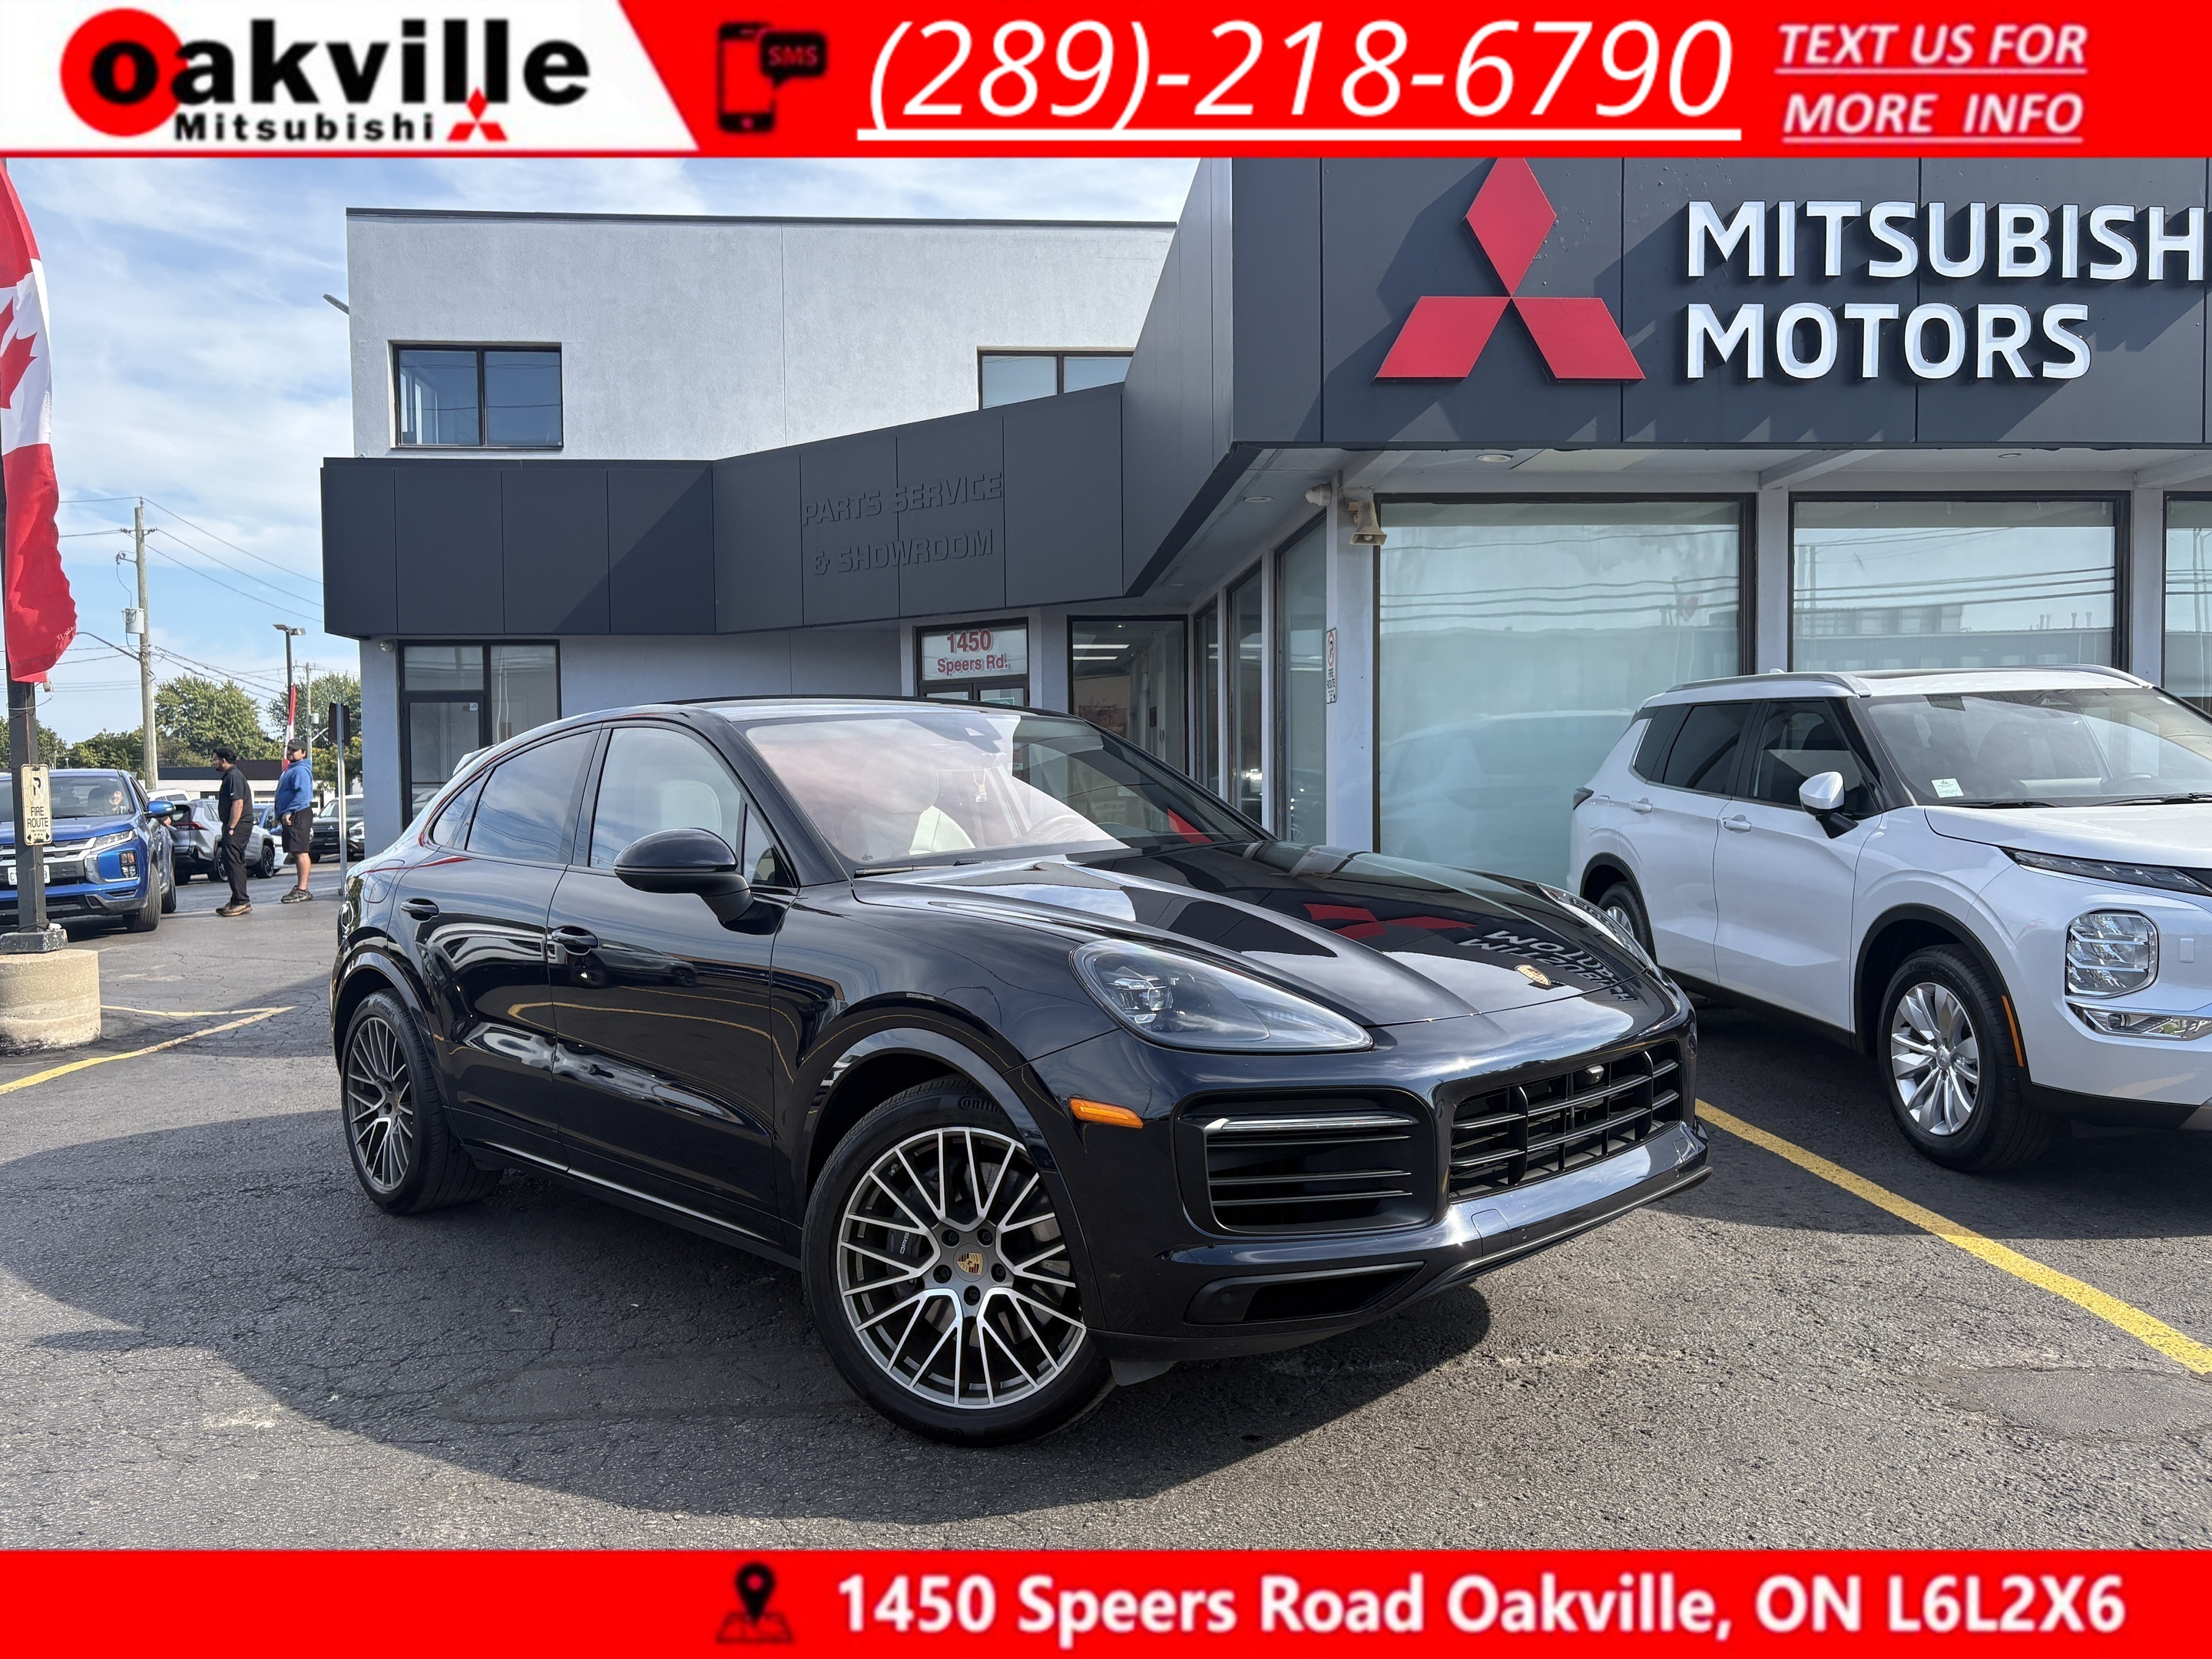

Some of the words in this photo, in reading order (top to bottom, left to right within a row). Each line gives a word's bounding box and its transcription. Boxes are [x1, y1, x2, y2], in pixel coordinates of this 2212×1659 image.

[1687, 200, 2206, 281] MITSUBISH
[1687, 303, 2092, 380] MOTORS
[803, 490, 882, 528] PARTS
[892, 472, 1002, 514] SERVICE
[813, 550, 830, 576] &
[837, 528, 994, 574] SHOWROOM
[945, 629, 992, 654] 1450
[937, 656, 982, 677] Speers
[985, 653, 1009, 671] Rd.
[27, 817, 48, 829] ROUTE
[31, 806, 45, 816] FIRE
